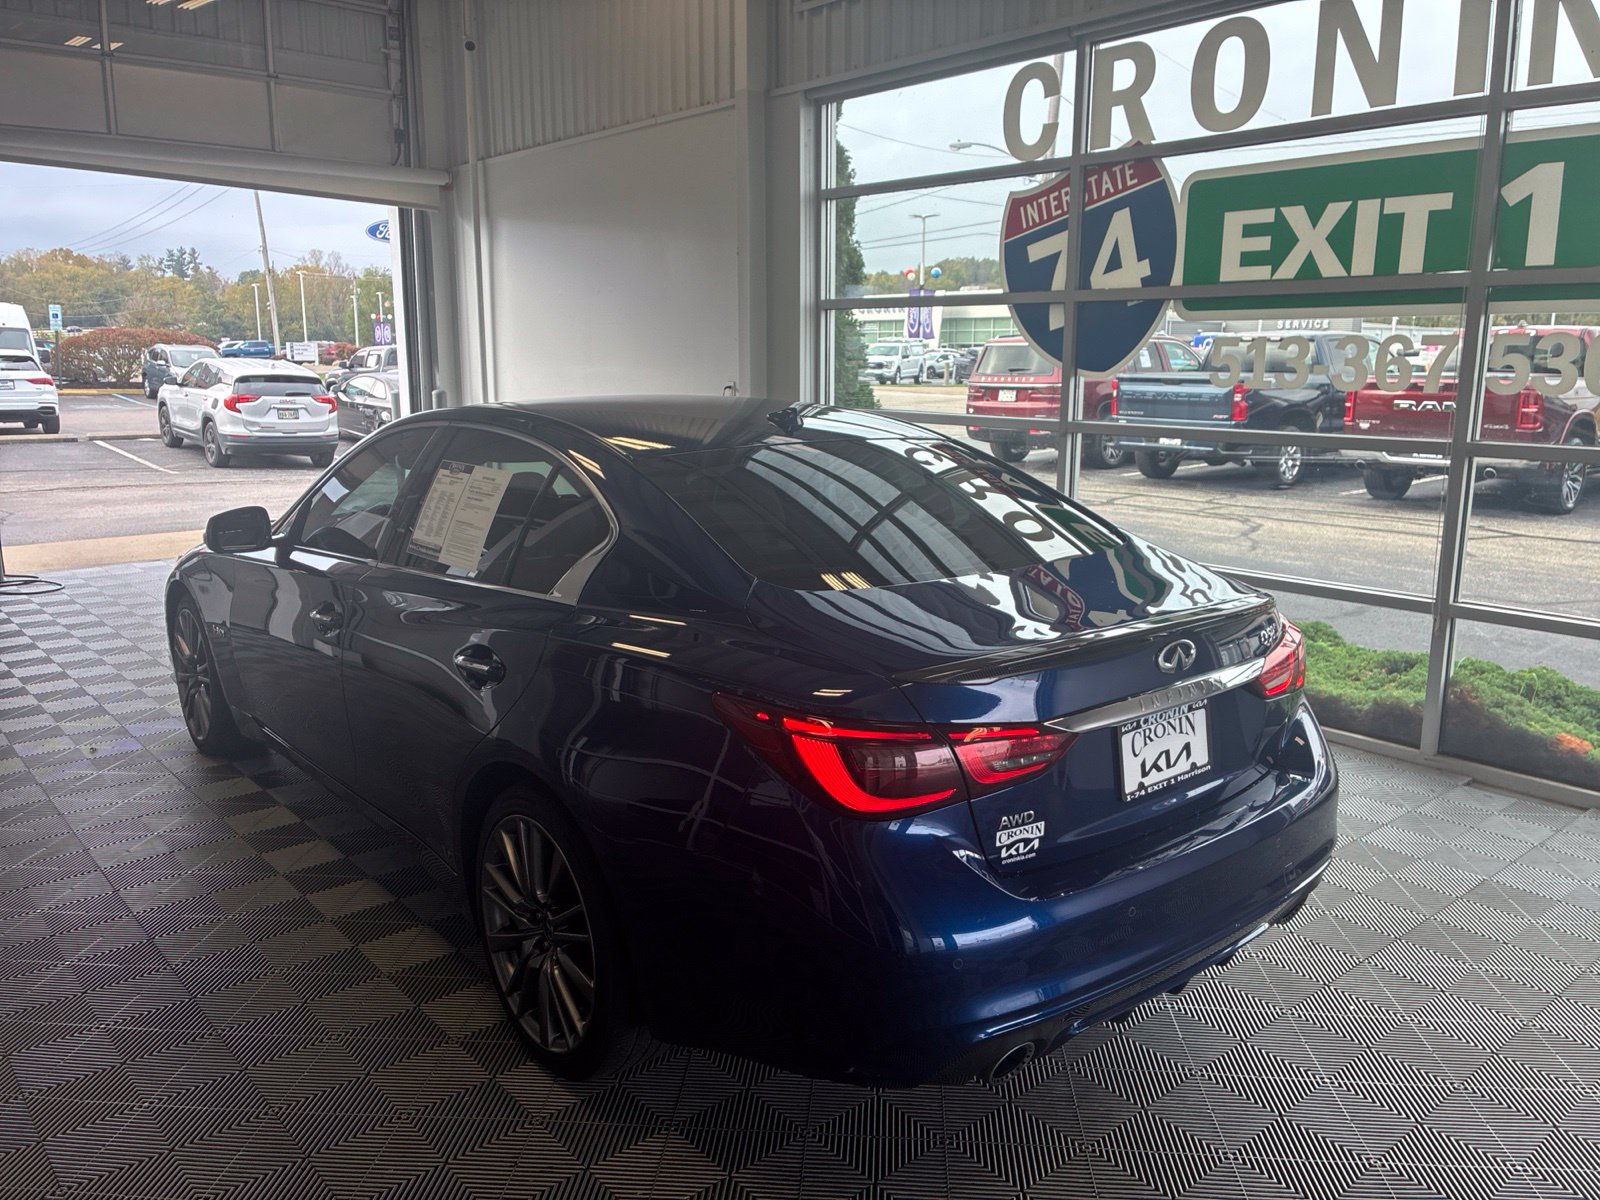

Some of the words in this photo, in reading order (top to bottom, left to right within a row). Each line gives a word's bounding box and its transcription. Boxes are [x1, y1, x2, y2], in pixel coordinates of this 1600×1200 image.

[1003, 0, 1600, 162] CRONIN
[1020, 161, 1138, 229] INTERTATE
[1219, 192, 1453, 282] EXIT
[1500, 161, 1565, 267] 1
[1026, 207, 1152, 331] 74
[1277, 319, 1330, 329] SERVICE
[1131, 712, 1196, 758] CRONIN
[1140, 704, 1189, 727] CRONIN
[1126, 790, 1146, 802] I-74
[1147, 781, 1168, 794] EXIT
[1170, 777, 1175, 785] 1
[1177, 764, 1211, 782] Harrison
[998, 823, 1043, 844] CRONIN
[999, 810, 1035, 830] AWD
